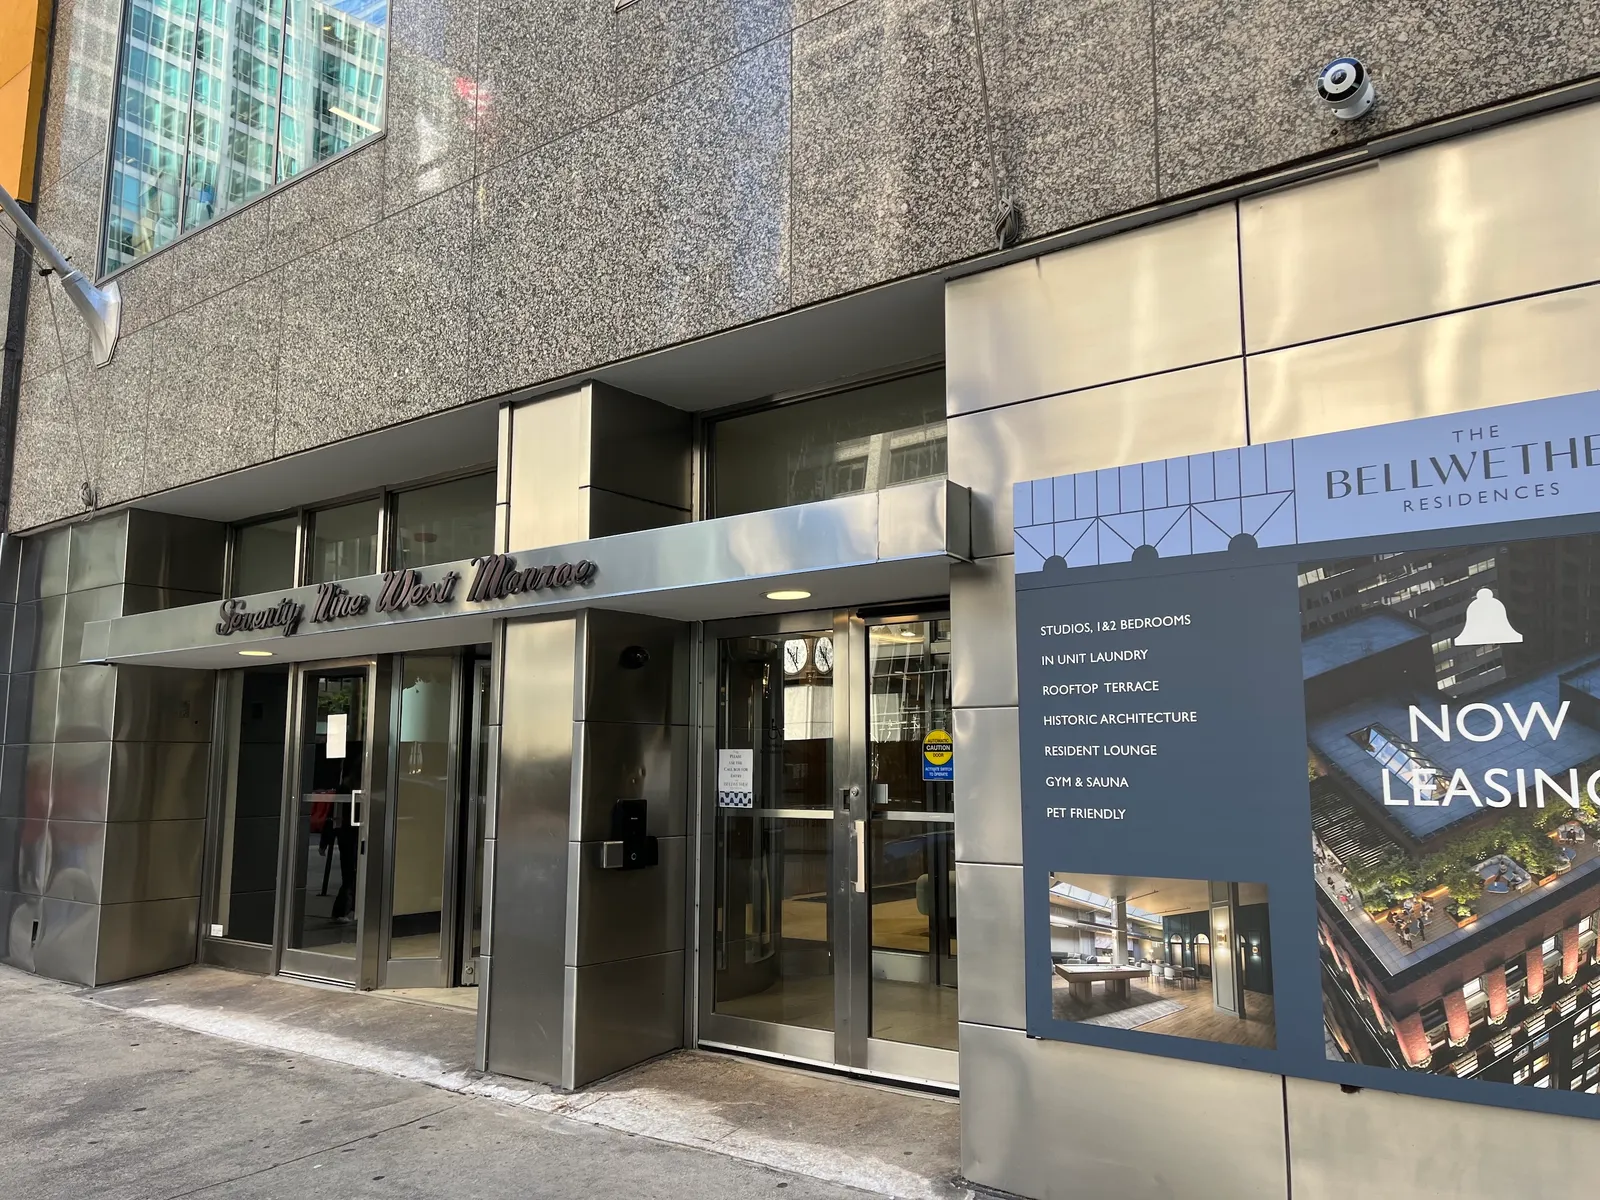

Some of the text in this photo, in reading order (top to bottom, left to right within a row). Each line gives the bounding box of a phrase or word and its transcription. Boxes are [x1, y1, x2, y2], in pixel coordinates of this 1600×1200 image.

[1452, 424, 1500, 443] THE
[1326, 433, 1600, 500] BELLWETHE
[1403, 481, 1560, 513] RESIDENCES
[215, 553, 596, 637] Seventy Nine West Monroe
[1040, 622, 1094, 636] STUDIOS,
[1120, 614, 1192, 630] BEDROOMS
[1041, 649, 1149, 666] IN UNIT LAUNDRY
[1042, 680, 1160, 695] ROOFTOP TERRACE
[1043, 711, 1198, 726] HISTORIC ARCHITECTURE
[1408, 700, 1571, 743] NOW
[1044, 744, 1158, 756] RESIDENT LOUNGE
[1045, 776, 1129, 788] GYM & SAUNA
[1046, 807, 1126, 820] PET FRIENDLY
